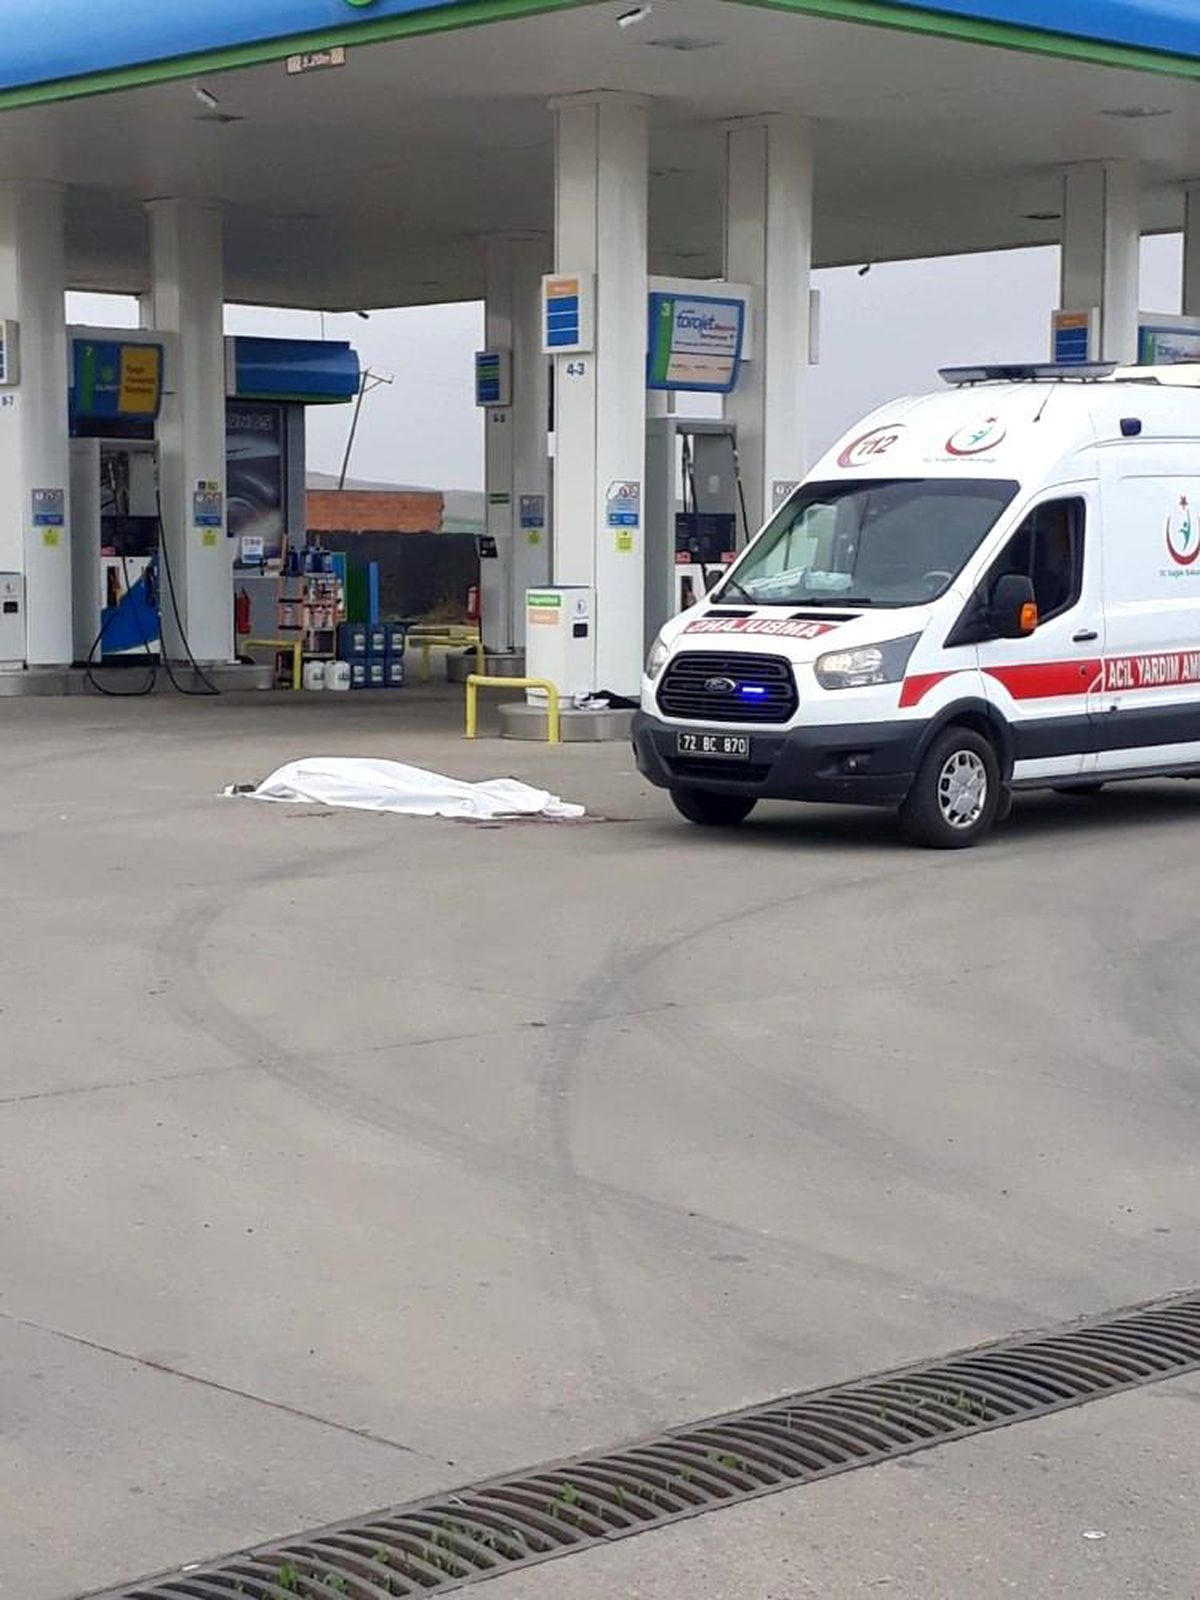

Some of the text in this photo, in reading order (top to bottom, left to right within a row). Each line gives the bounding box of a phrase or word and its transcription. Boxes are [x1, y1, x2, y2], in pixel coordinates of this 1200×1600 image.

[661, 302, 671, 317] 3
[566, 362, 585, 376] 4-3
[856, 434, 899, 457] 112
[1137, 655, 1179, 686] YARDIM
[683, 734, 746, 753] 72 BC 870
